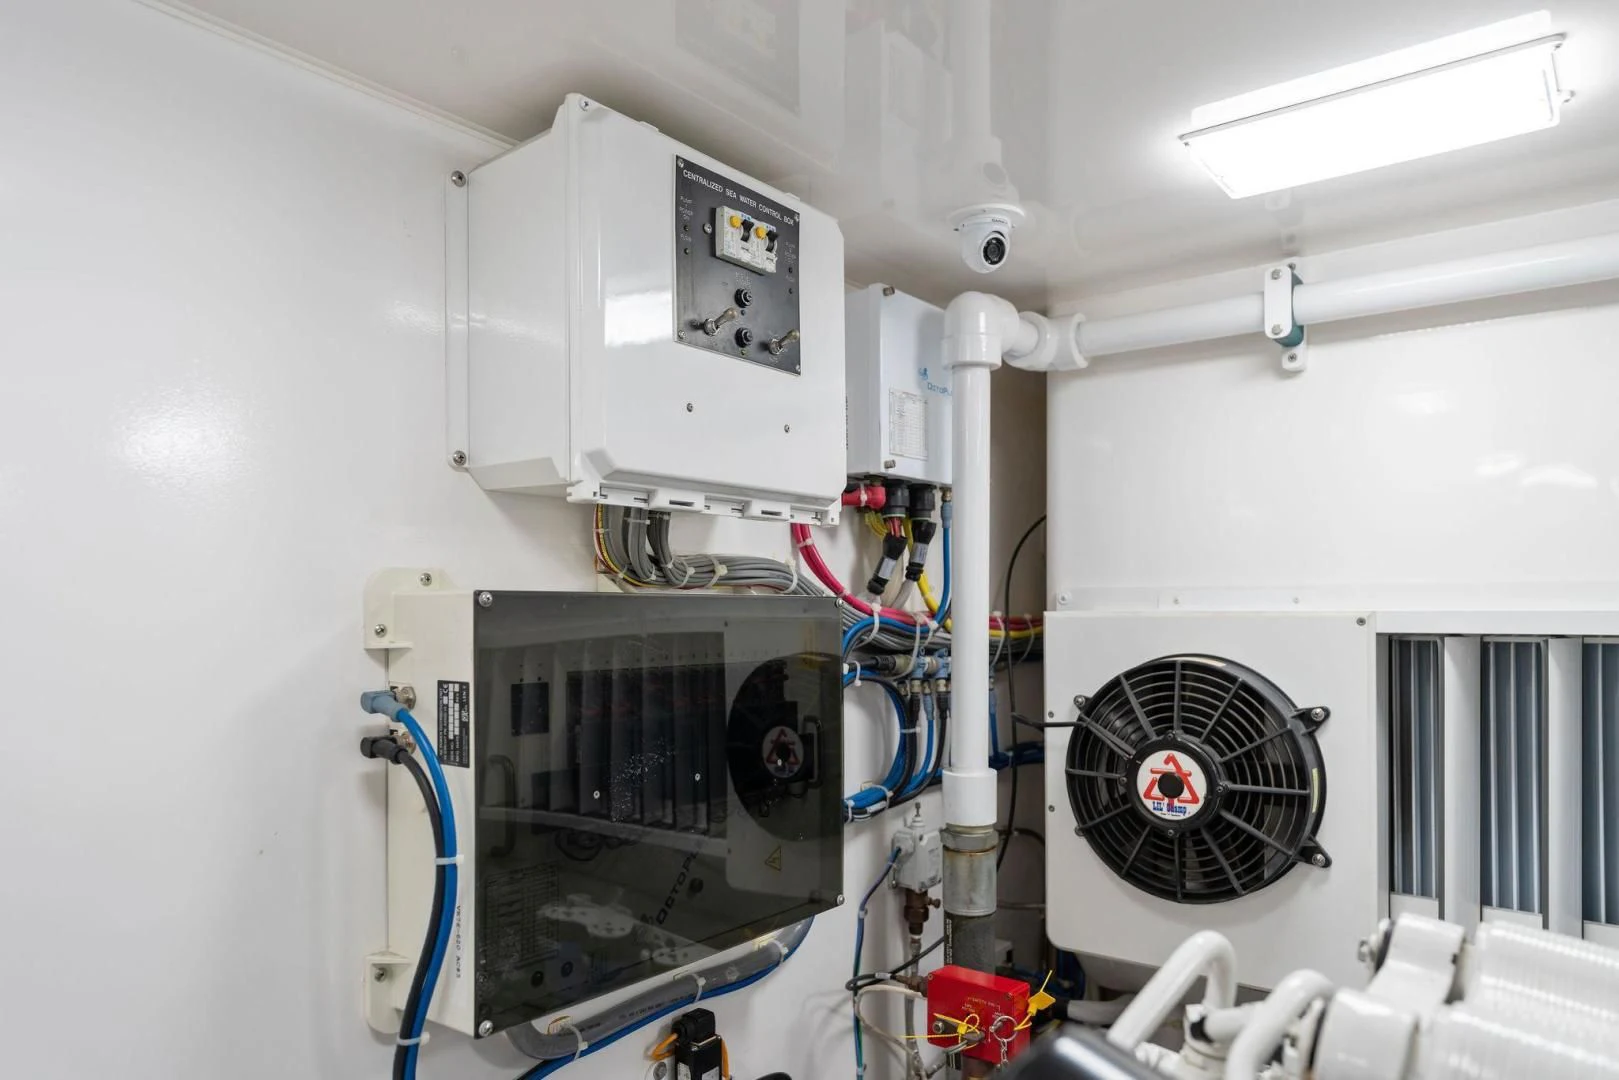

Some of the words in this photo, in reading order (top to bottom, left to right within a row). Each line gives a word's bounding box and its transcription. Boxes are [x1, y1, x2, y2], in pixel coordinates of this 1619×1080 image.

[683, 169, 724, 193] CENTRALIZED
[725, 188, 737, 199] SEA
[739, 194, 757, 209] WATER
[758, 203, 782, 221] CONTROL
[783, 216, 795, 226] BOX
